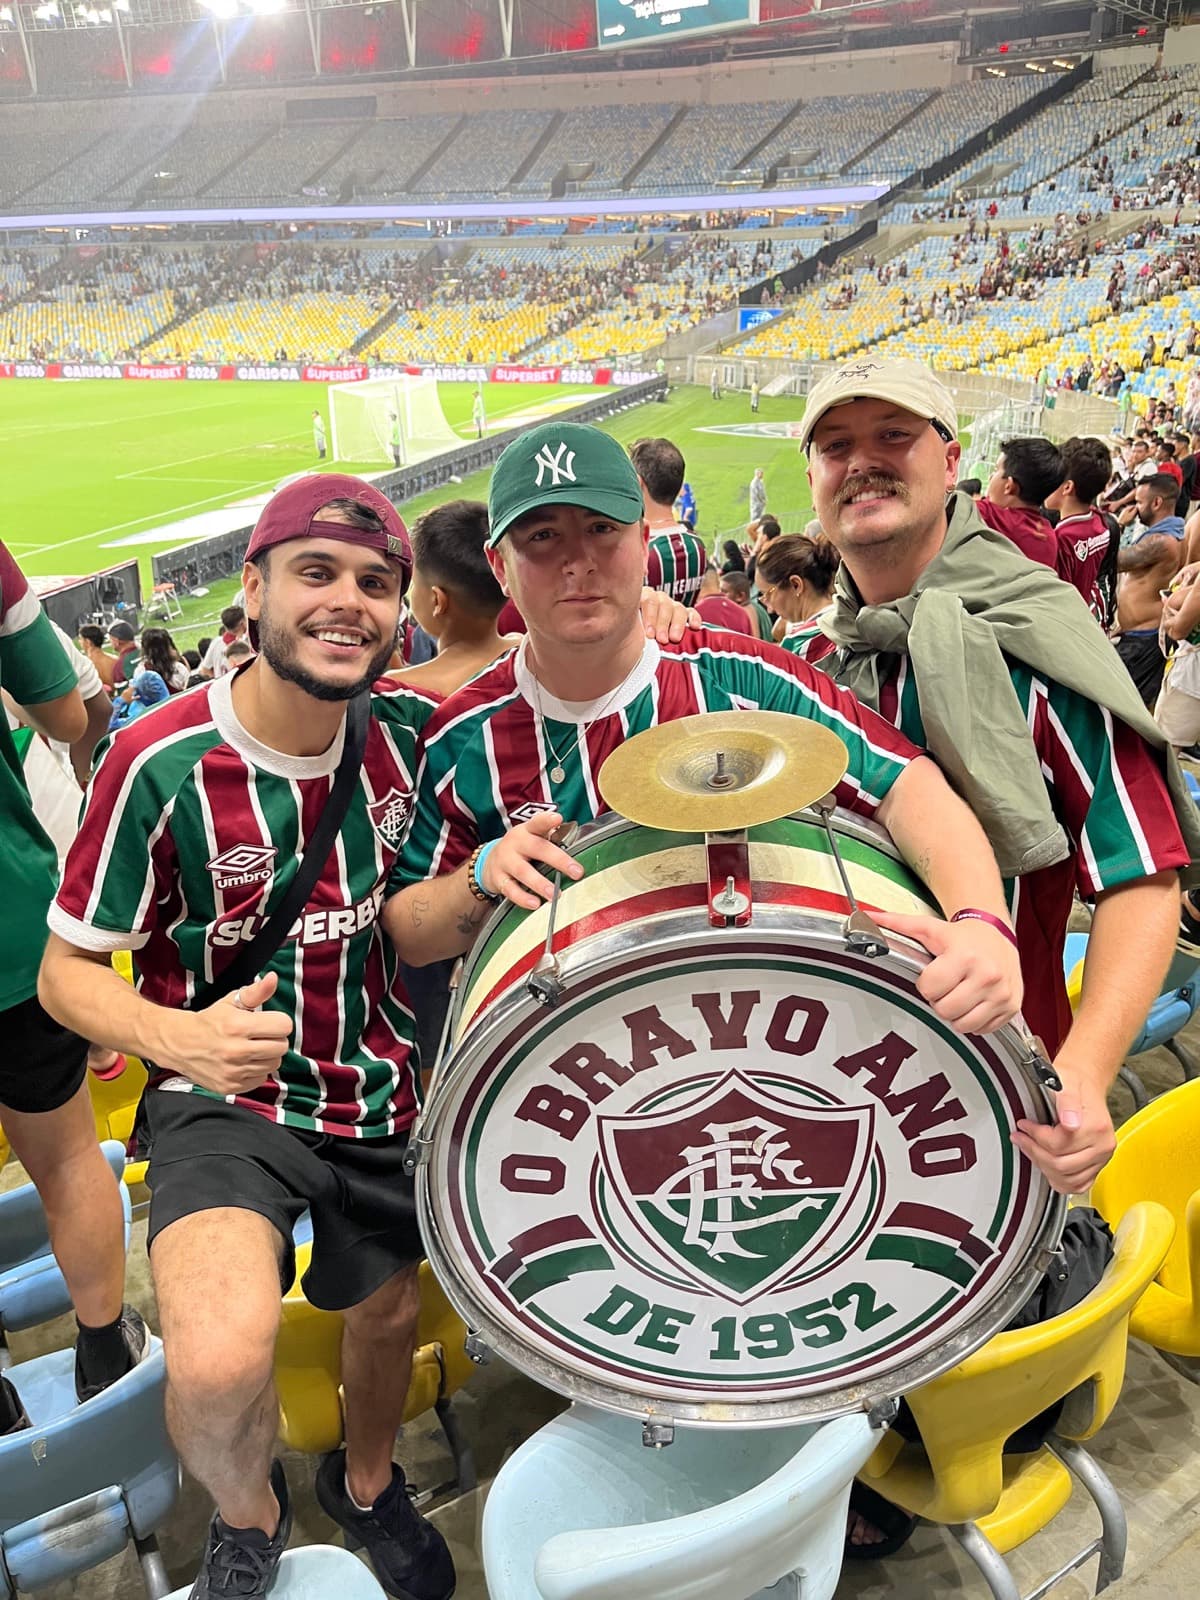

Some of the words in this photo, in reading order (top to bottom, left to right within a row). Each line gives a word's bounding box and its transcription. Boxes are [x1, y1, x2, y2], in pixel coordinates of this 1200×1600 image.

[16, 365, 45, 378] 2026
[62, 366, 122, 378] CARIOCA
[128, 366, 181, 379] SUPERBET
[187, 366, 218, 379] 2026
[237, 367, 299, 380] CARIOCA
[306, 367, 363, 380] SUPERBET
[422, 368, 488, 382] CARIOCA
[495, 369, 555, 382] SUPERBET
[561, 370, 593, 383] 2026
[217, 868, 272, 889] umbro
[514, 990, 830, 1141] BRAVO
[833, 1031, 978, 1178] ANO
[500, 1153, 566, 1195] O
[583, 1283, 696, 1355] DE
[709, 1281, 897, 1361] 1952
